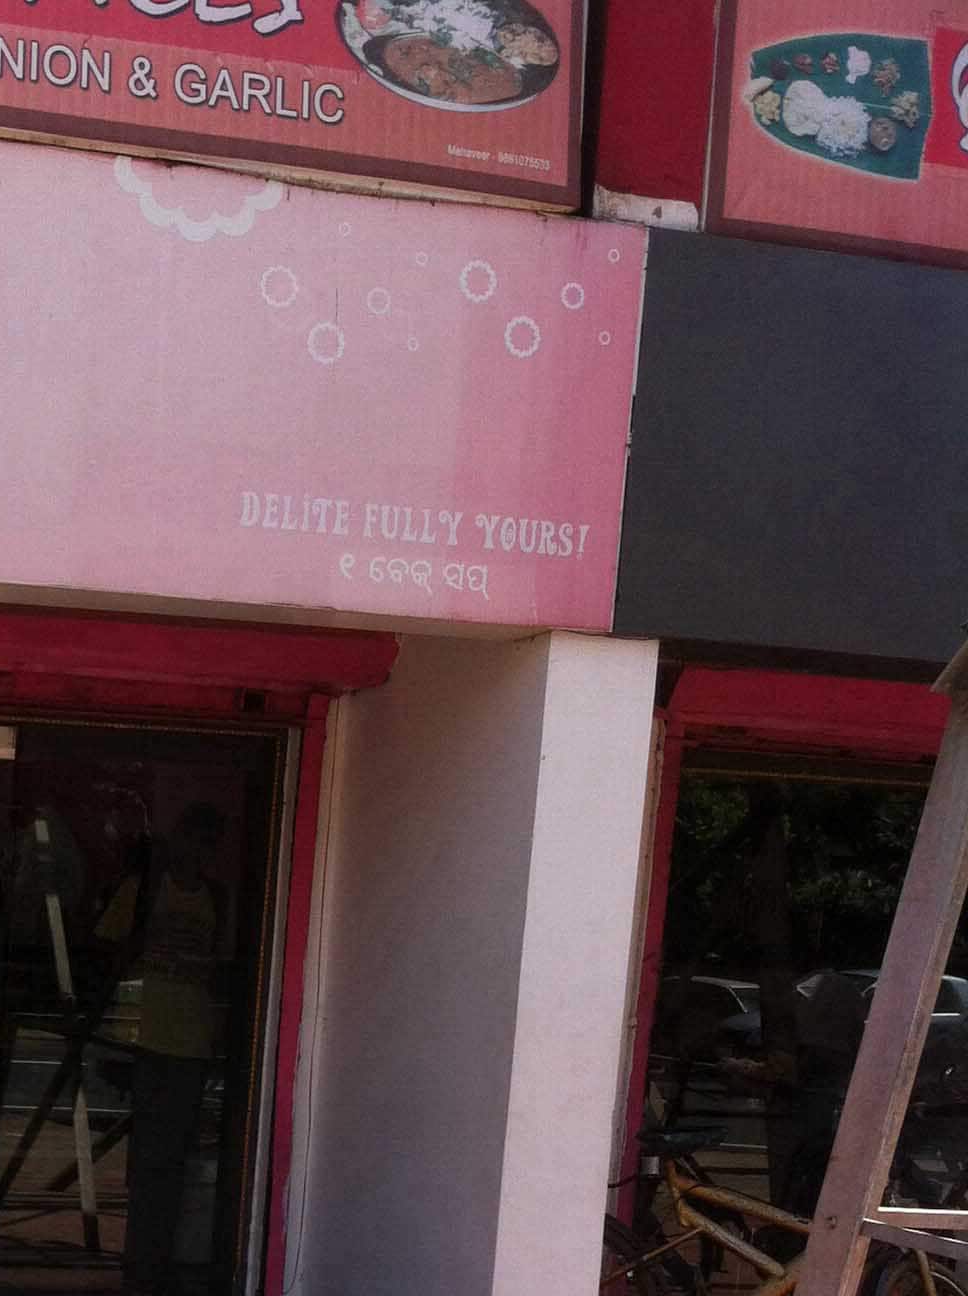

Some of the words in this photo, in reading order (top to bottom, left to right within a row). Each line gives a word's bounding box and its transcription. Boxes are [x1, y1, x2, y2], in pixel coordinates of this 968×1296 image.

[128, 56, 158, 99] &
[174, 62, 345, 123] GARLIC
[363, 503, 465, 546] FULLY
[475, 515, 592, 560] YOURS!
